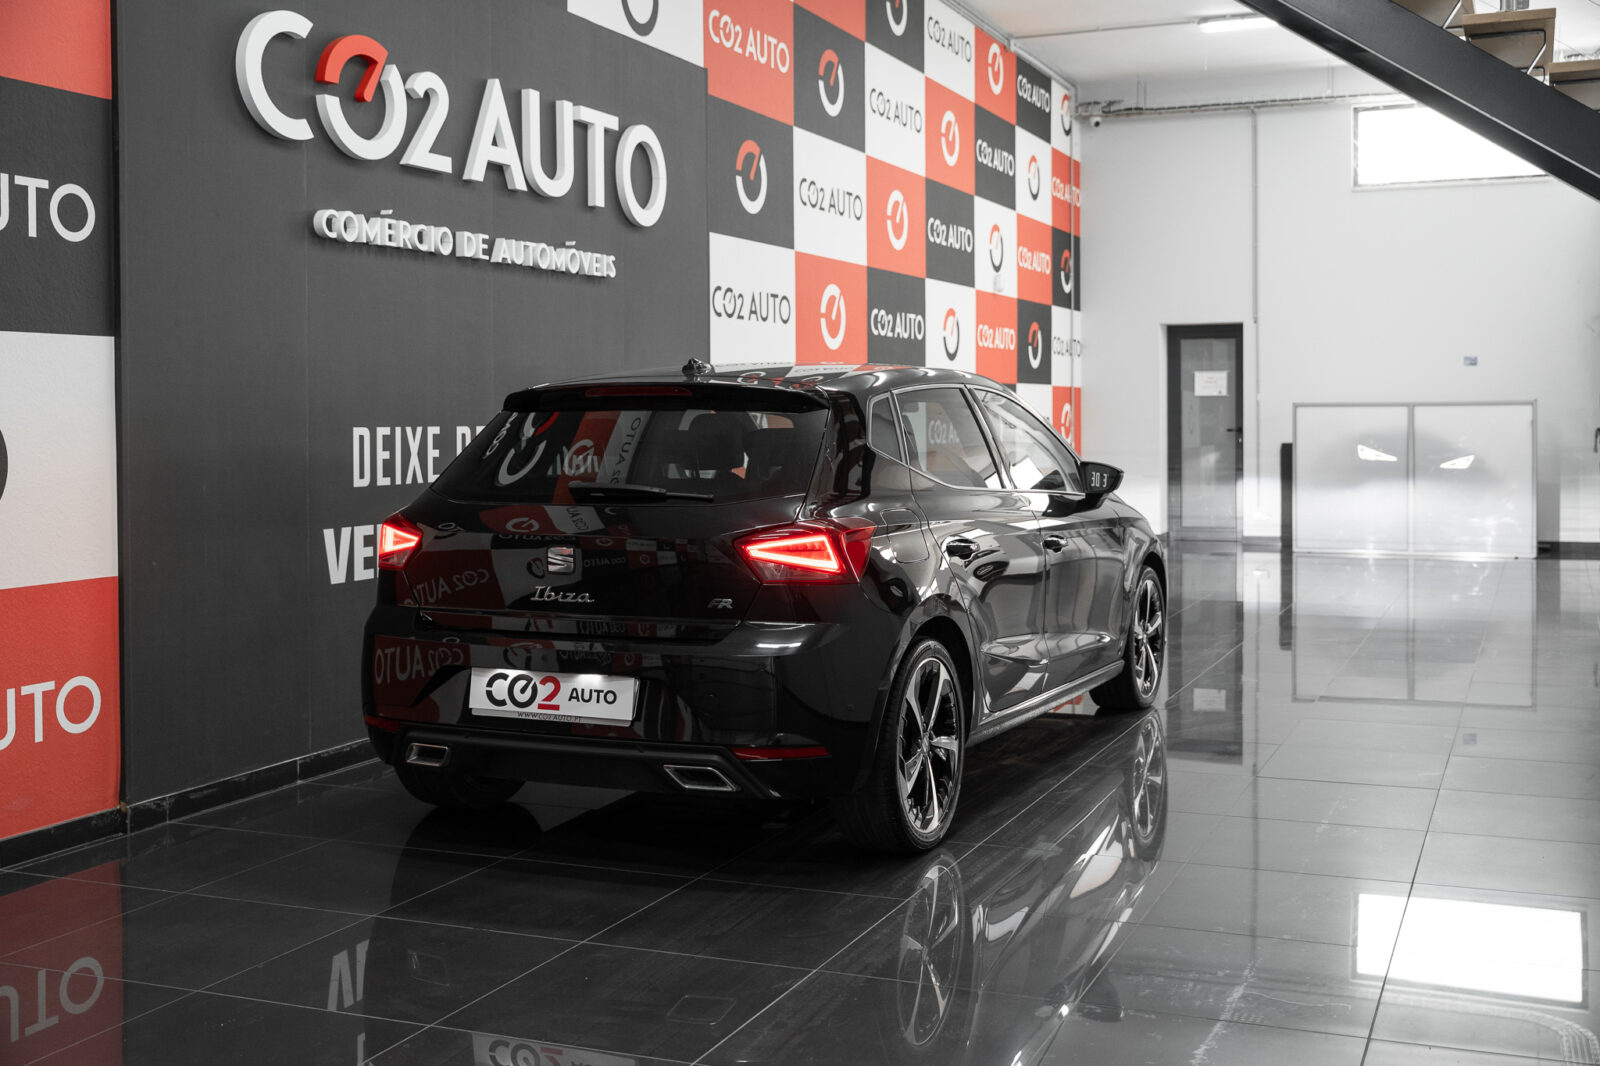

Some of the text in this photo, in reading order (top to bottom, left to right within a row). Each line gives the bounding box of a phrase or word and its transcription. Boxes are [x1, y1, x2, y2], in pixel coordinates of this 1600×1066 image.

[709, 9, 790, 74] CO2 AUTO
[927, 16, 972, 63] CO2 AUTO
[235, 9, 668, 228] CO2 AUTO
[870, 88, 923, 134] CO2 AUTO
[976, 138, 1014, 177] CO2 AUTO
[799, 177, 863, 221] CO2 AUTO
[313, 209, 616, 278] COMÉRCIO DE AUTOMÓVEIS
[928, 217, 973, 253] CO2 AUTO
[712, 285, 791, 325] CO2 AUTO
[871, 308, 924, 340] CO2 AUTO
[976, 323, 1016, 351] CO2 AUTO
[352, 426, 441, 488] DEIXE
[322, 523, 383, 584] VE
[530, 585, 595, 602] Ibiza
[707, 598, 733, 609] FR
[485, 672, 617, 711] CO2 AUTO
